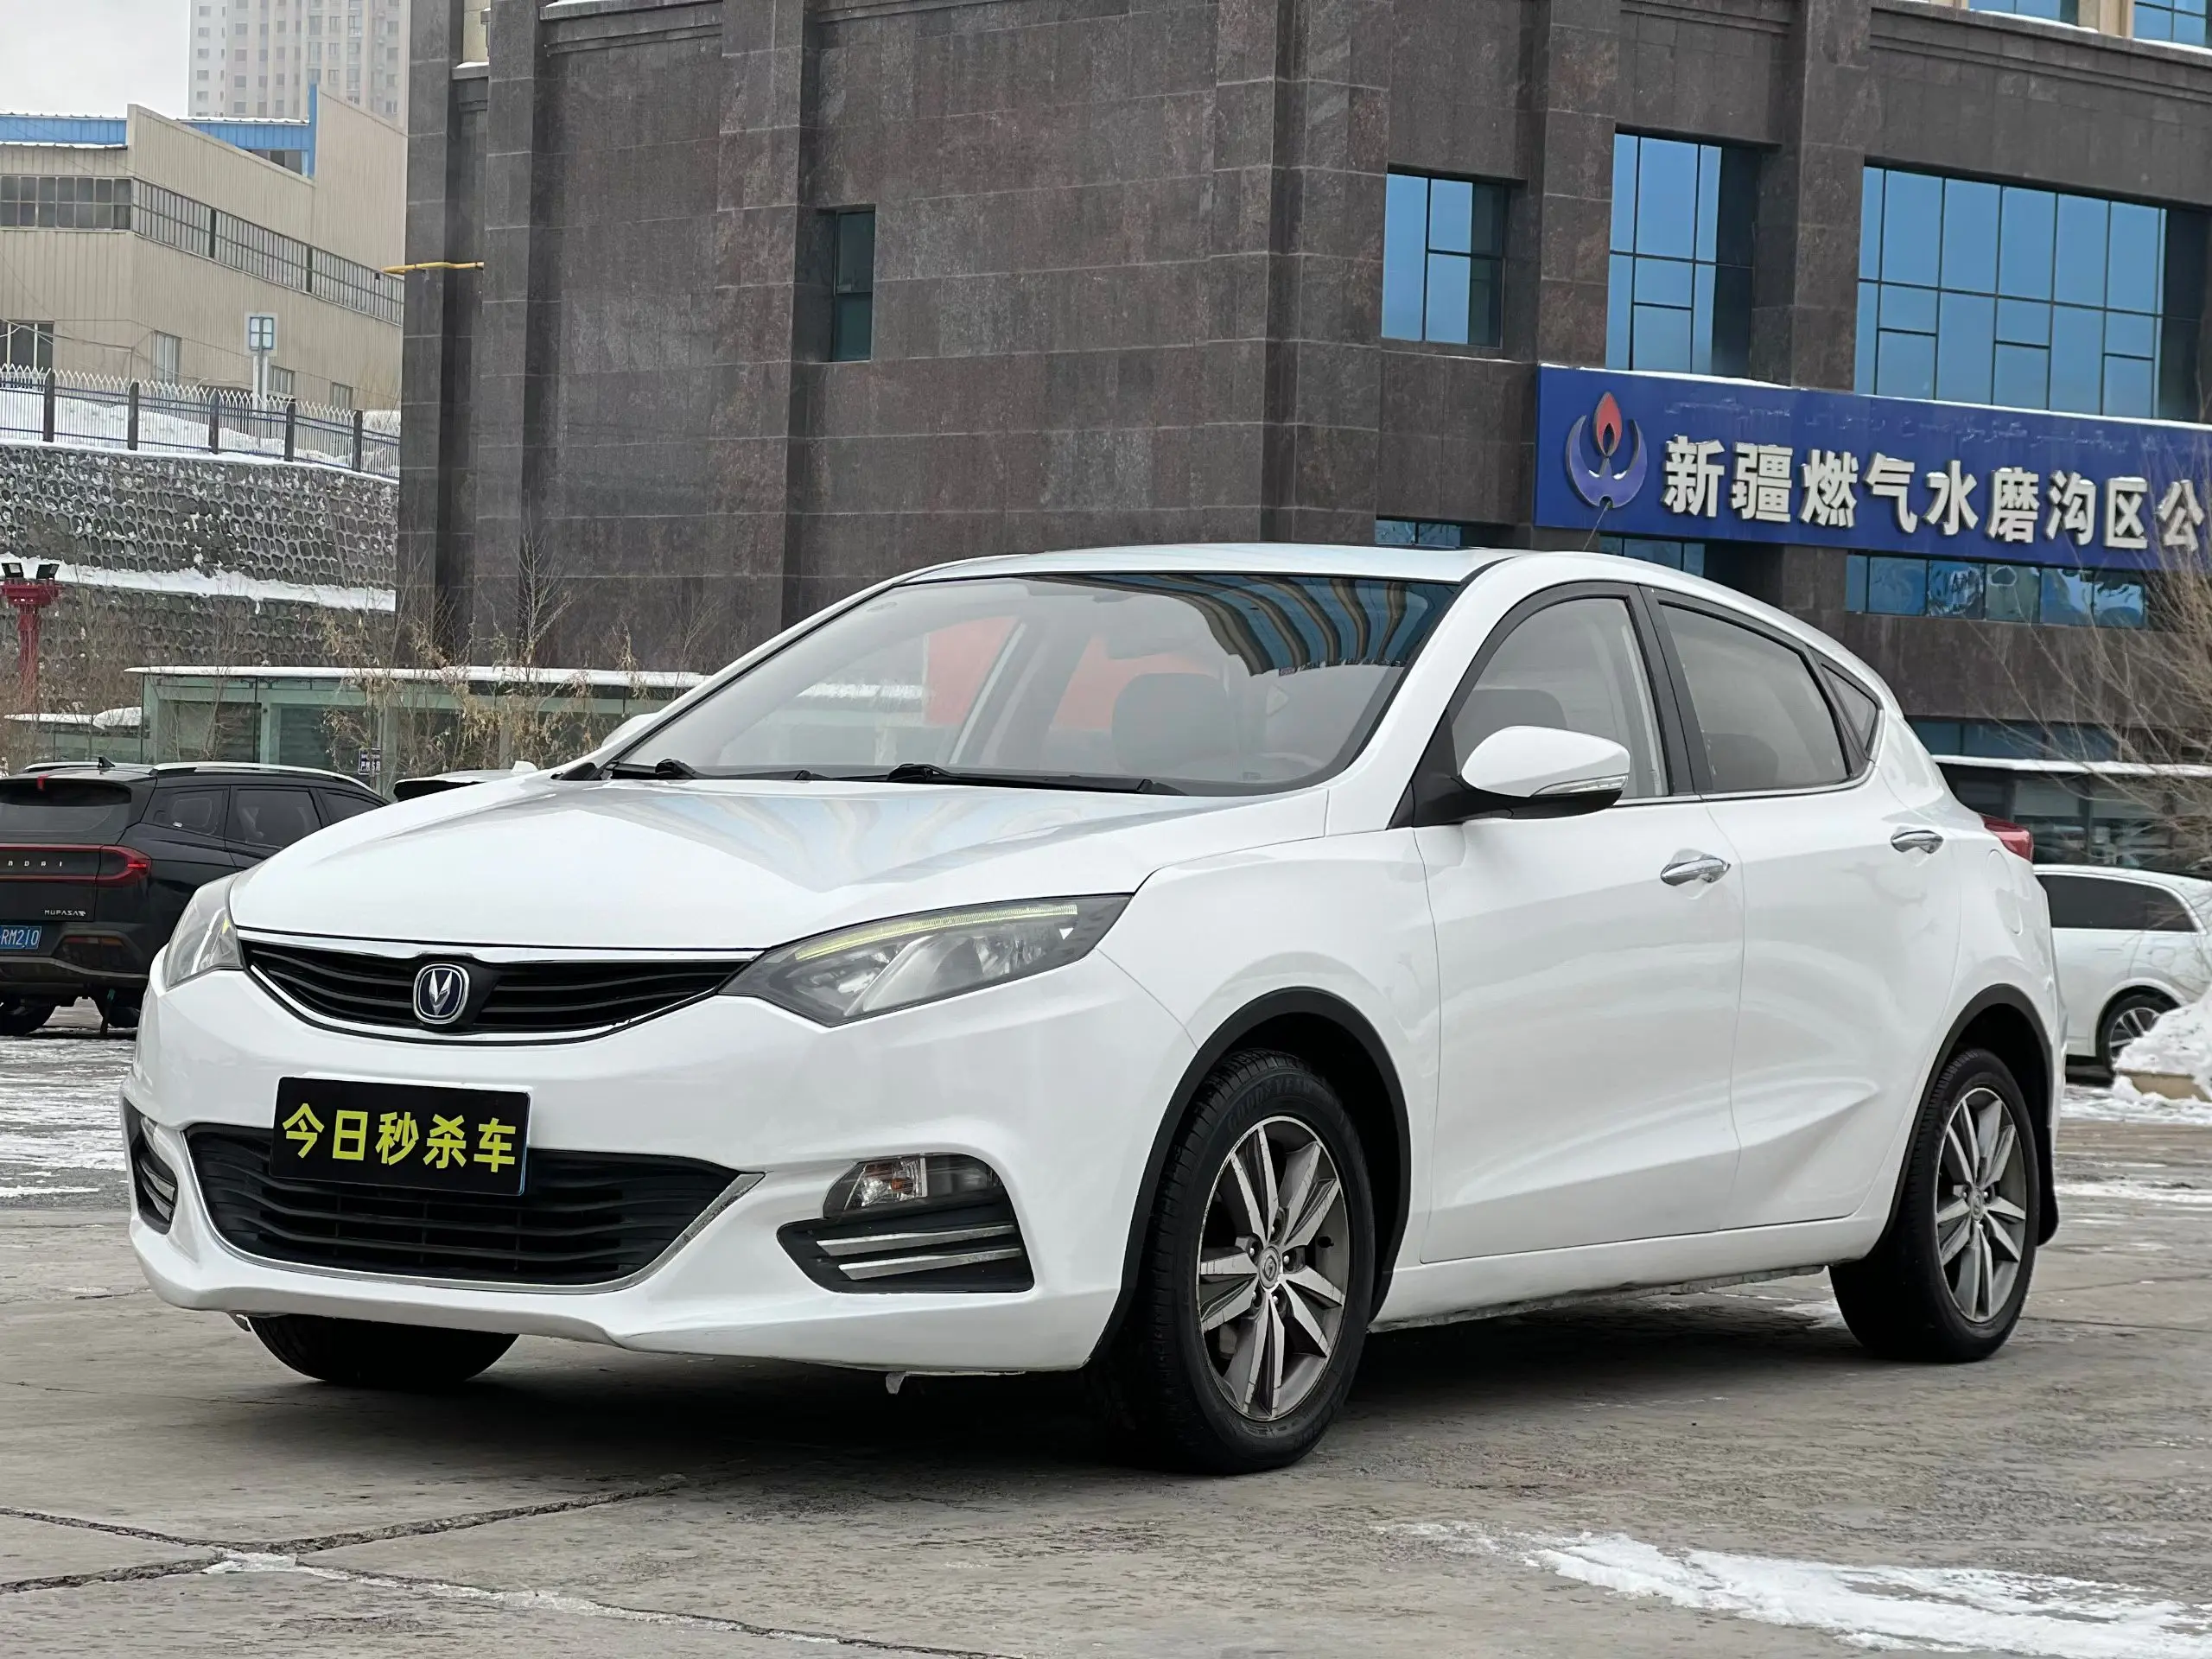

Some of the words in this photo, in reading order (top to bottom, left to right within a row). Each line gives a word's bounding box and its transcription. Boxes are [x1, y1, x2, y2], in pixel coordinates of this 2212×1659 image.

[1662, 434, 2203, 552] 新疆燃气水磨沟区公
[282, 1103, 517, 1173] 今日秒杀车
